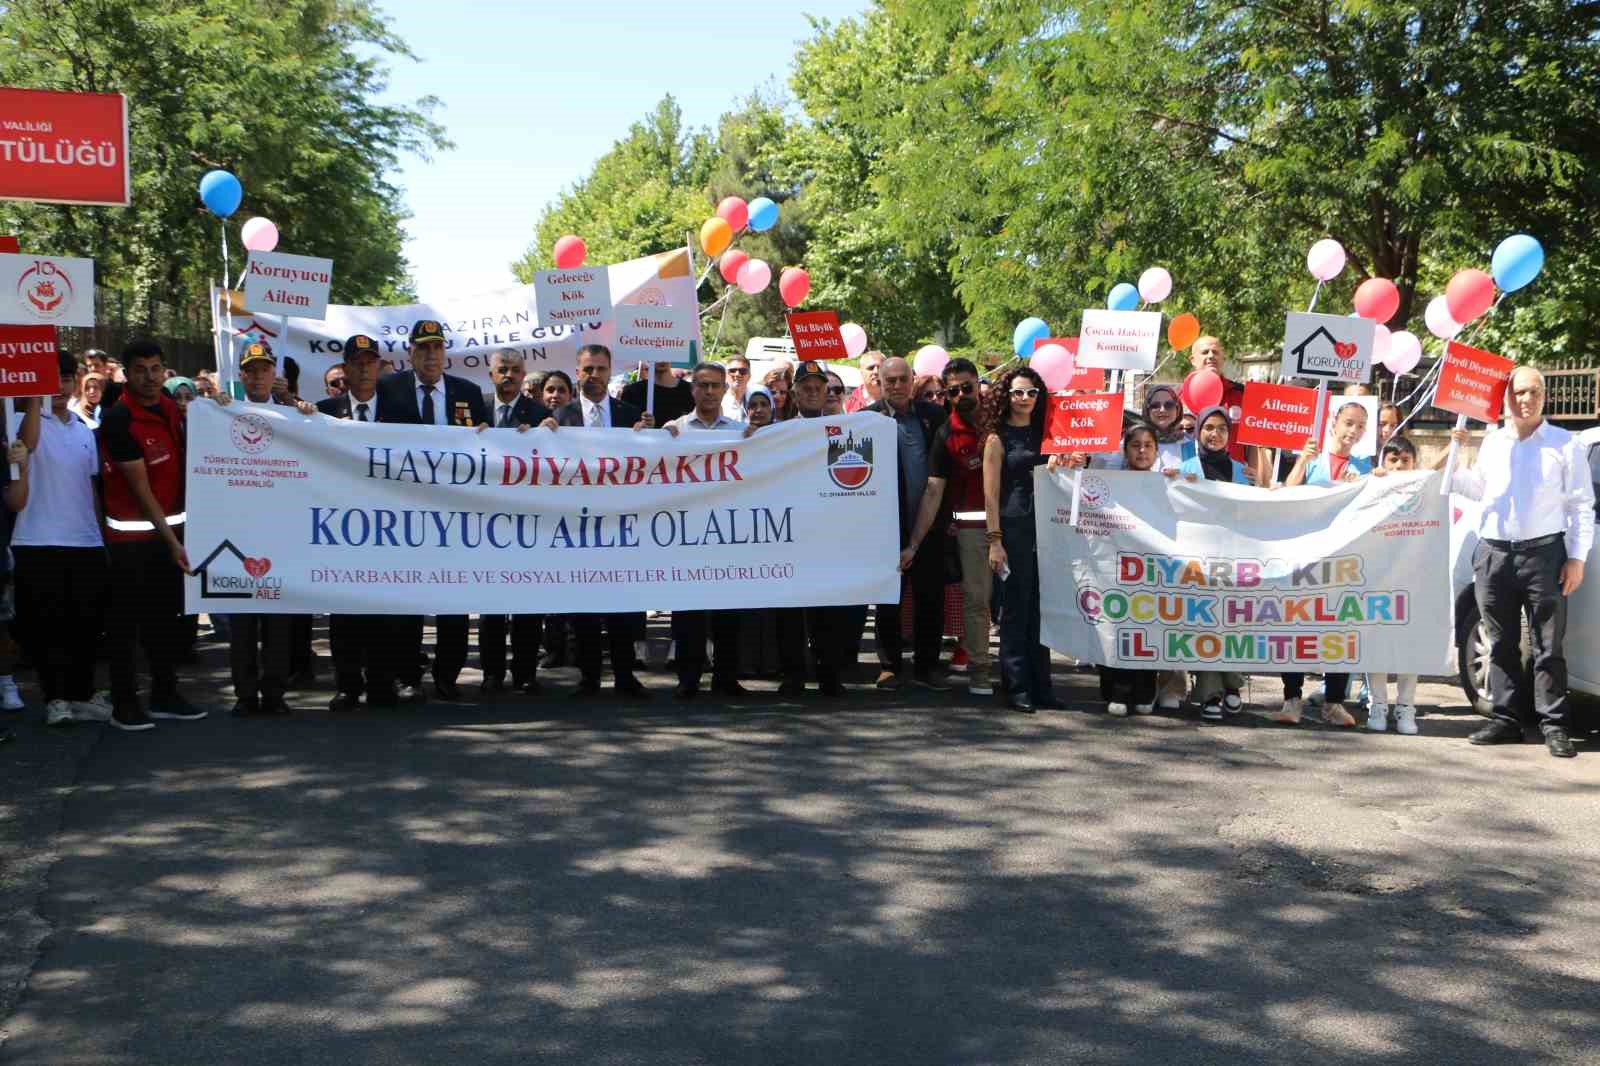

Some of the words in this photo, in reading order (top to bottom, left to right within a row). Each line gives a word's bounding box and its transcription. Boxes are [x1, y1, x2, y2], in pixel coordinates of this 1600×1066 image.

[0, 137, 117, 167] TÜLÜĞÜ
[250, 260, 329, 283] Koruyucu
[264, 289, 310, 306] Ailem
[561, 291, 585, 301] Kök
[382, 325, 409, 336] 30
[631, 318, 674, 329] Ailemiz
[466, 331, 521, 348] AİLE
[620, 336, 685, 348] Geleceğimiz
[1307, 356, 1364, 369] KORUYUCU
[1059, 399, 1110, 412] Geleceğe
[1261, 398, 1311, 415] Ailemiz
[1070, 416, 1095, 429] Kök
[1244, 415, 1314, 435] Geleceğimi
[367, 446, 488, 486] HAYDİ
[502, 449, 744, 487] DİYARBAKIR
[309, 507, 542, 549] KORUYUCU
[550, 506, 641, 548] AİLE
[651, 507, 794, 548] OLALIM
[212, 576, 283, 589] KORUYUCU
[311, 567, 424, 584] DİYARBAKIR
[427, 567, 470, 584] AİLE
[472, 570, 497, 584] VE
[500, 569, 568, 585] SOSYAL
[571, 566, 668, 583] HİZMETLER
[671, 564, 686, 582] İL
[687, 563, 795, 581] MÜDÜRLÜĞÜ
[1079, 590, 1219, 626] ÇOCUK
[1227, 593, 1405, 624] HAKLARI
